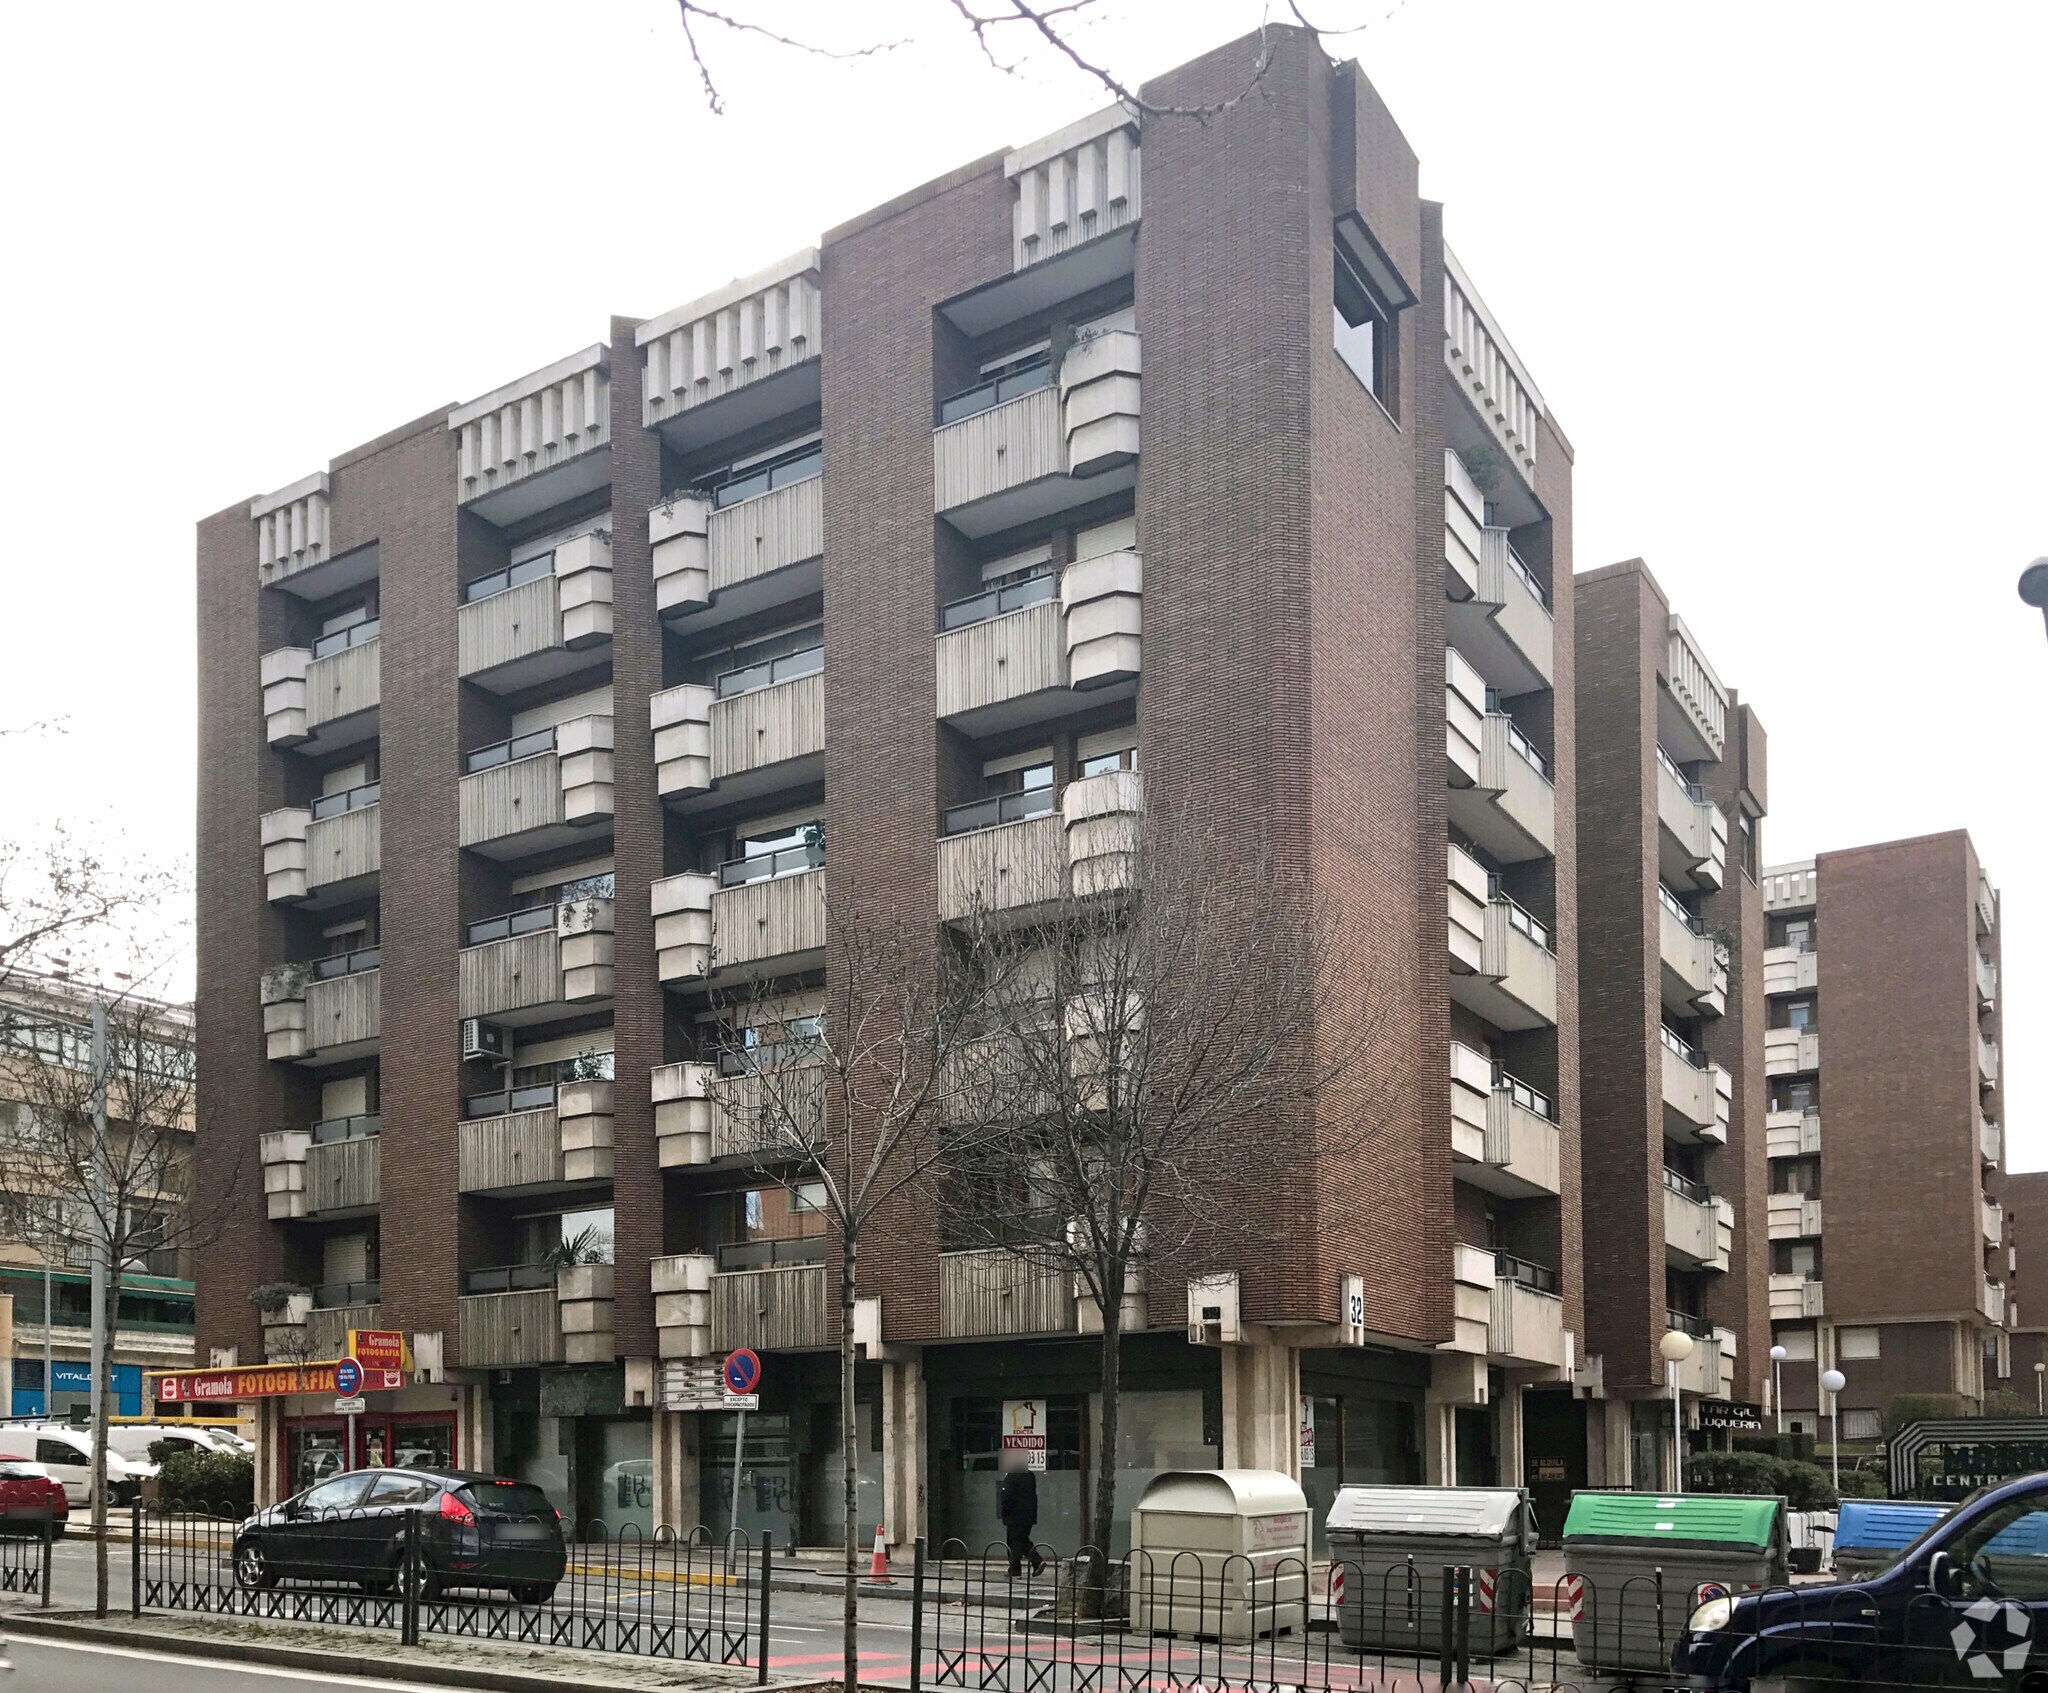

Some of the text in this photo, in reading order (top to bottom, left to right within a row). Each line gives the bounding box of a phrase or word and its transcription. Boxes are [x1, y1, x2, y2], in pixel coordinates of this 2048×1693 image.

[1350, 1295, 1362, 1324] 32
[368, 1334, 400, 1348] Gramola
[357, 1348, 400, 1357] FOTOGRAFIA
[56, 1372, 118, 1382] VITALDT
[194, 1377, 233, 1397] Gramola
[237, 1369, 336, 1395] FOTOGRAFIA
[1005, 1436, 1044, 1448] VENDIDO
[1037, 1451, 1045, 1464] 15
